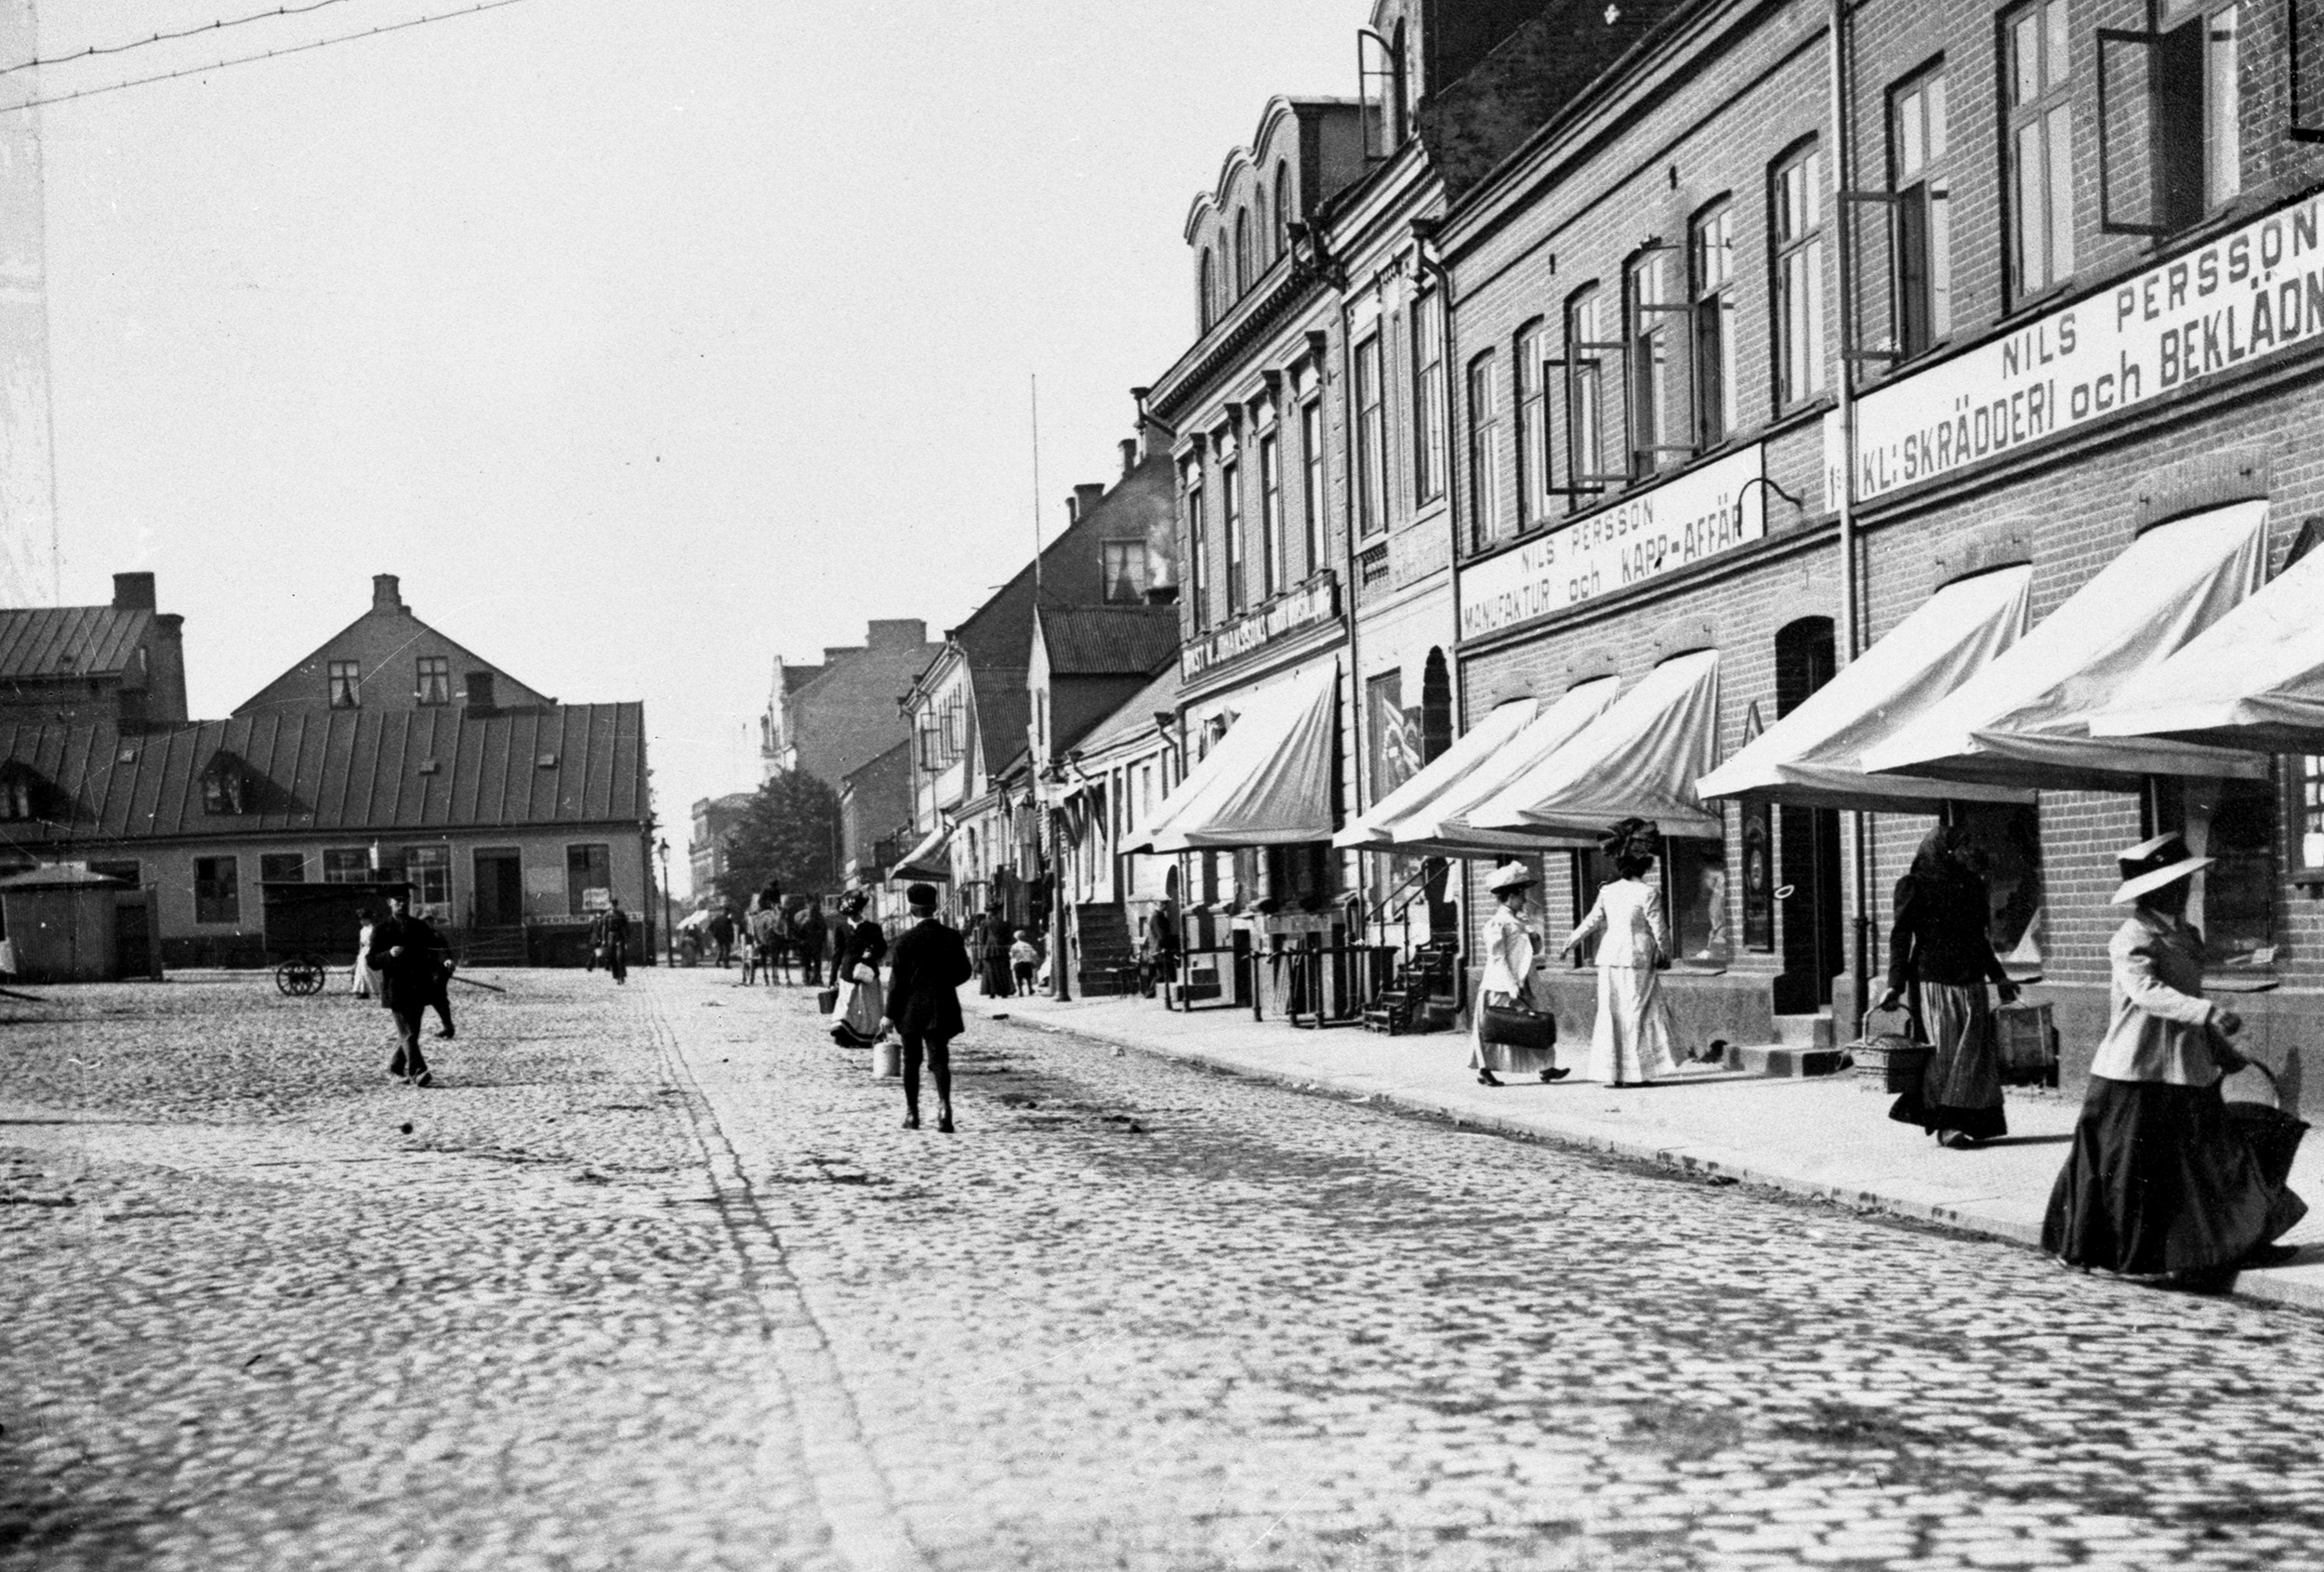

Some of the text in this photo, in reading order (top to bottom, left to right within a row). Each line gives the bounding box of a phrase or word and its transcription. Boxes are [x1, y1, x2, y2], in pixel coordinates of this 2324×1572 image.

[2002, 201, 2318, 379] NILS PERSSON
[2071, 350, 2141, 420] och
[1521, 495, 1654, 574] NILS PERSSON
[1463, 578, 1551, 632] MANUFAKTUR
[1569, 559, 1601, 601] och
